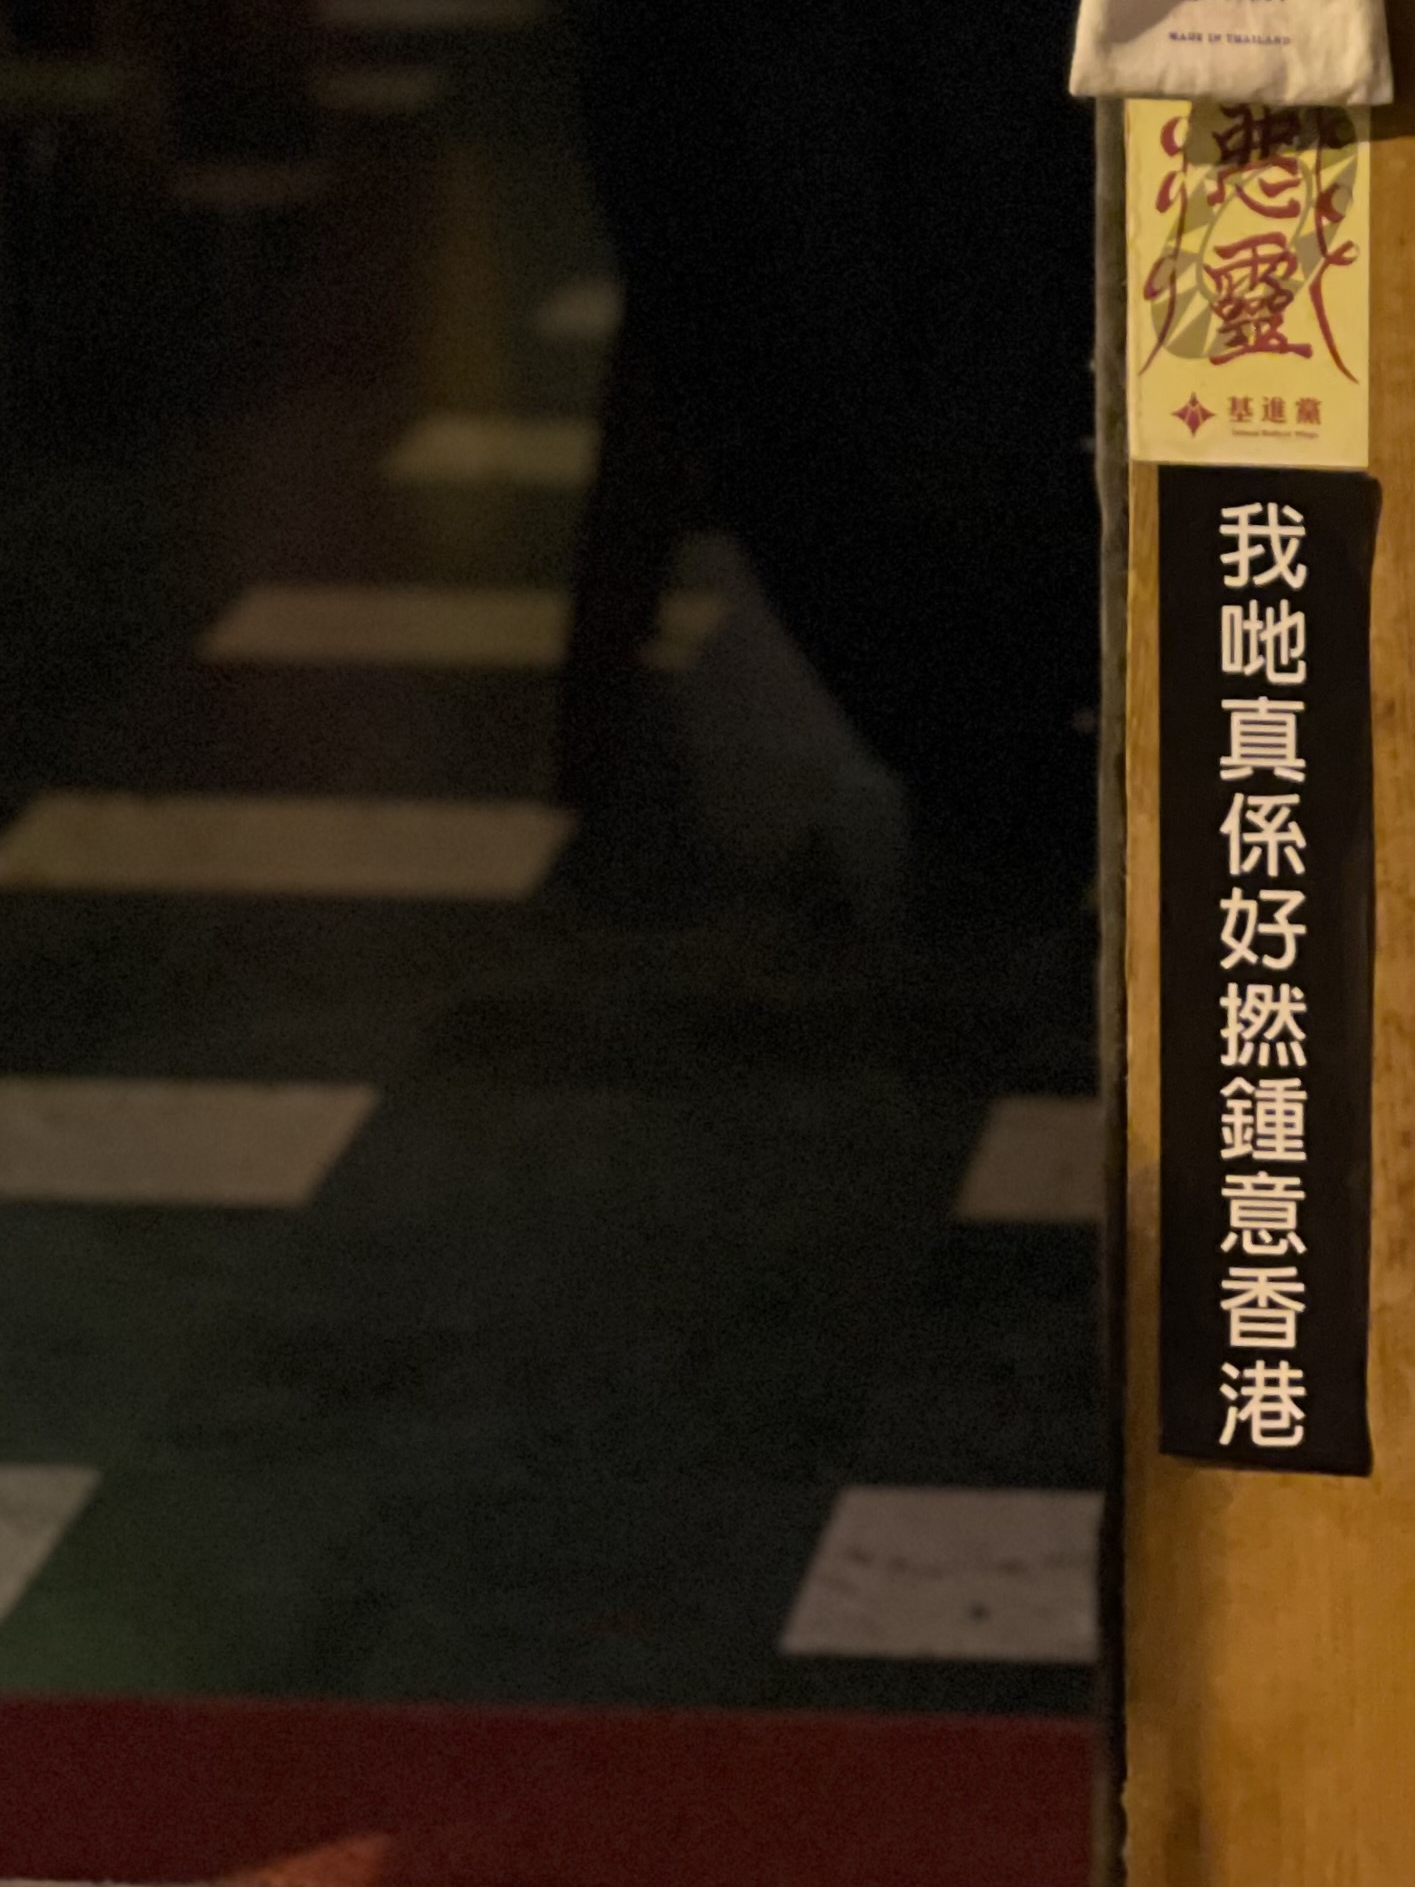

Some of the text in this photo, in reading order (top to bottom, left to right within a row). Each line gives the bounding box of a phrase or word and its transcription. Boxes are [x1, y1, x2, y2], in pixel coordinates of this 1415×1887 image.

[1226, 396, 1322, 425] 基進黨
[1219, 501, 1307, 1447] 我哋真係好撚鍾意香港
